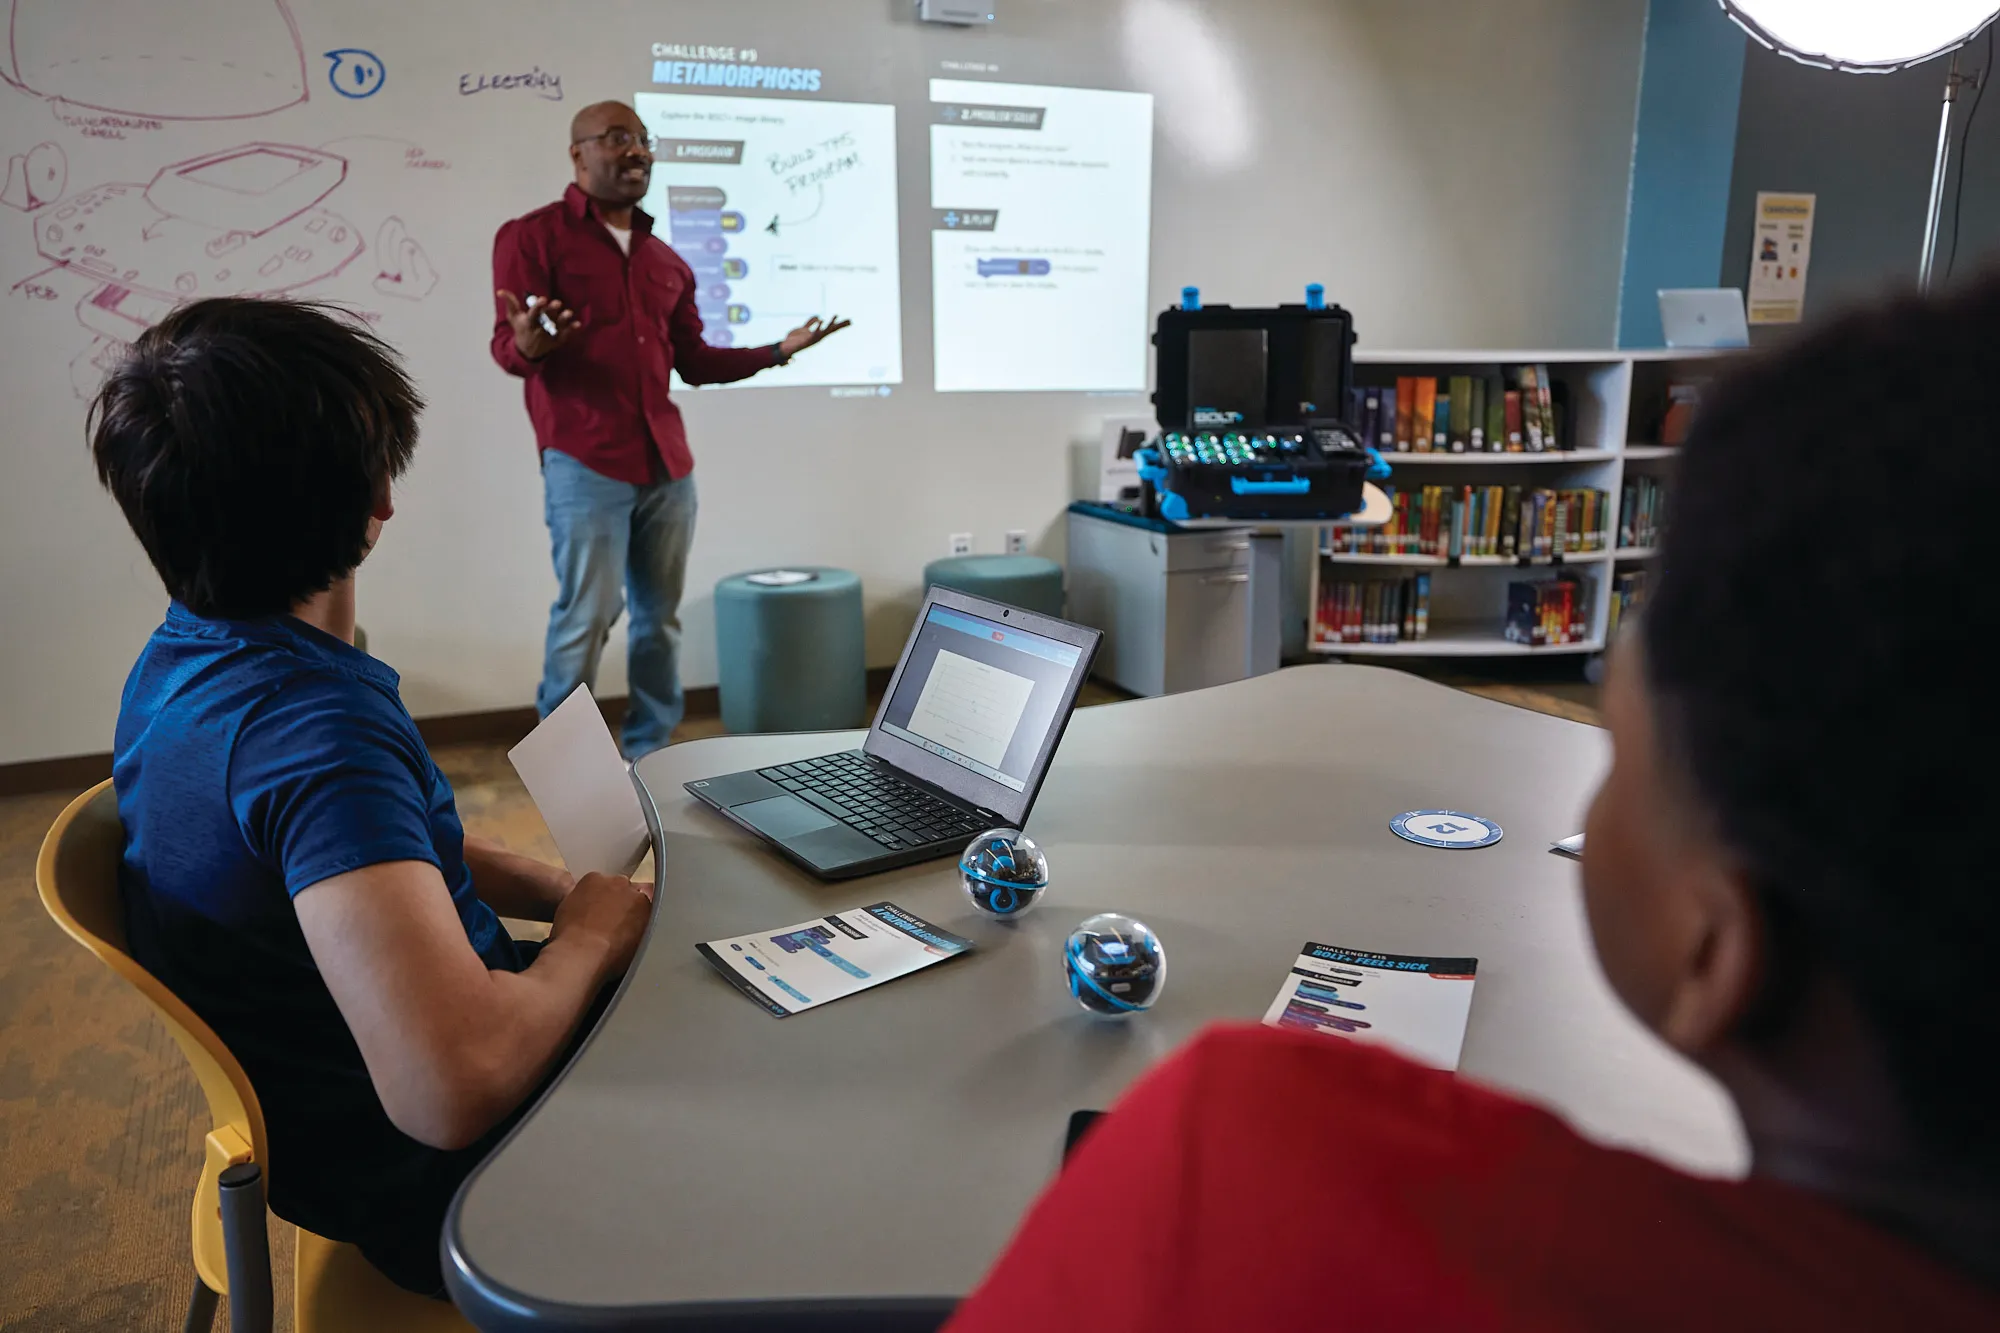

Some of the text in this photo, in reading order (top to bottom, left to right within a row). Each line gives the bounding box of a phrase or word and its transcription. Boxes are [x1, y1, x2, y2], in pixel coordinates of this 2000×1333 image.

[651, 43, 758, 62] CHALLENGE #9
[652, 60, 822, 91] METAMORPHOSIS
[1426, 821, 1469, 835] 12
[884, 905, 917, 923] CHALLENGE
[1312, 949, 1352, 963] BOLT+
[1354, 956, 1395, 969] FEELS
[1396, 962, 1429, 971] SICK
[1316, 945, 1371, 958] CHALLENGE
